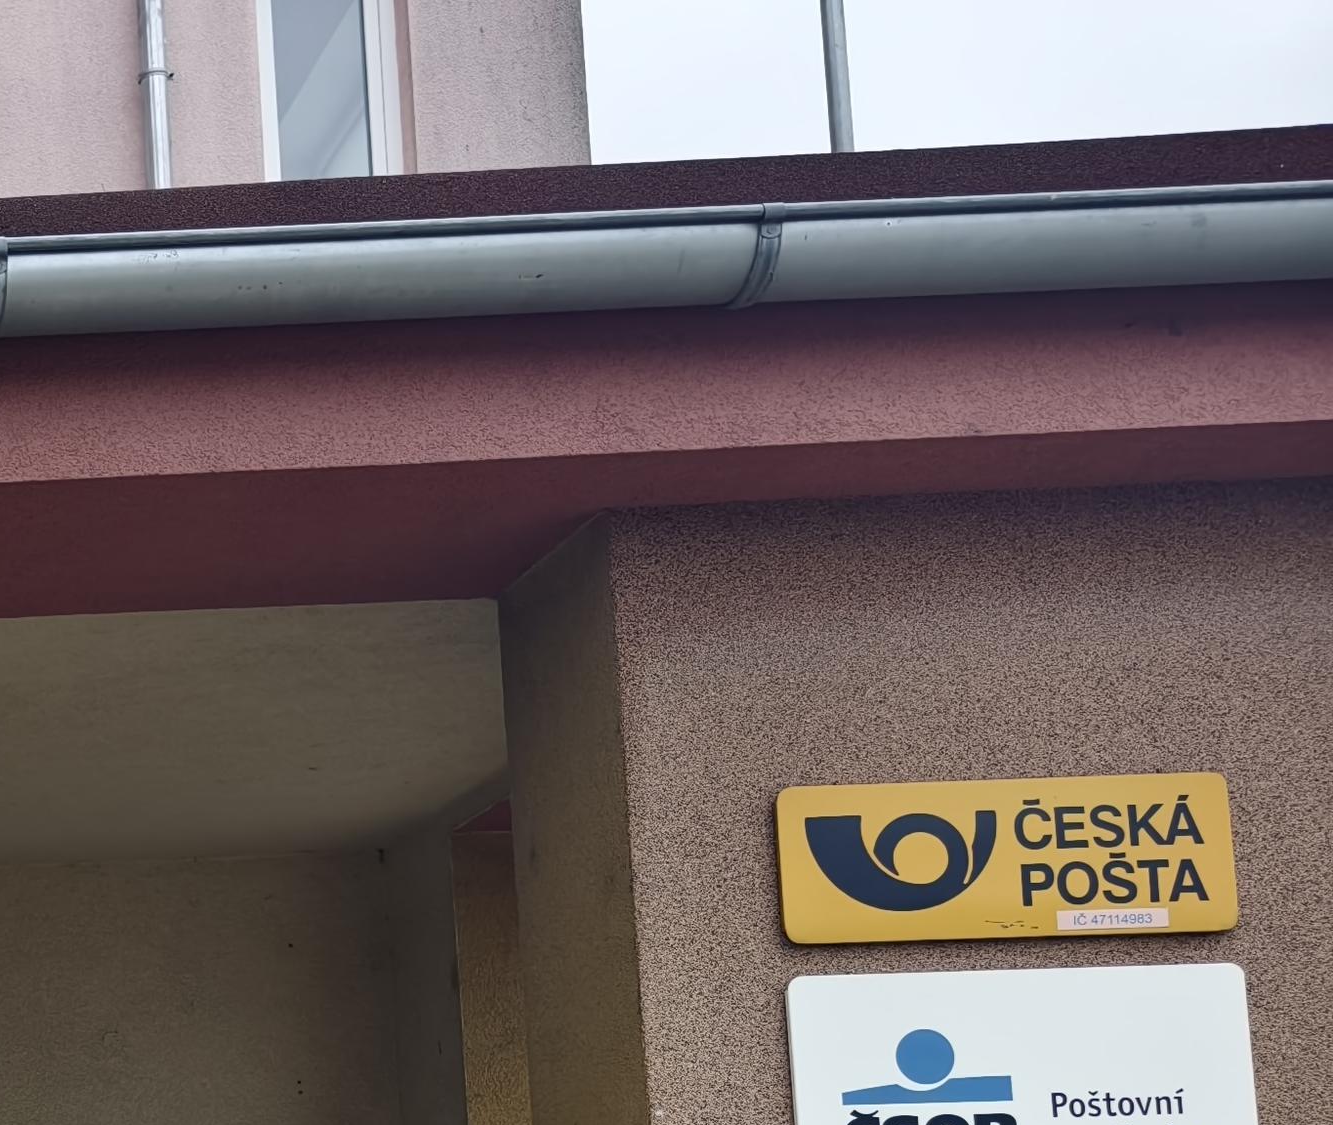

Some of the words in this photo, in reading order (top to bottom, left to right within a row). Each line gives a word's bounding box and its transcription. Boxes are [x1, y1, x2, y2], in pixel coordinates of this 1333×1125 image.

[1014, 795, 1204, 850] ČESKÁ
[1020, 852, 1210, 907] POŠTA
[1072, 911, 1088, 926] IČ
[1090, 911, 1153, 926] 47114983
[1051, 1088, 1185, 1118] Poštovní
